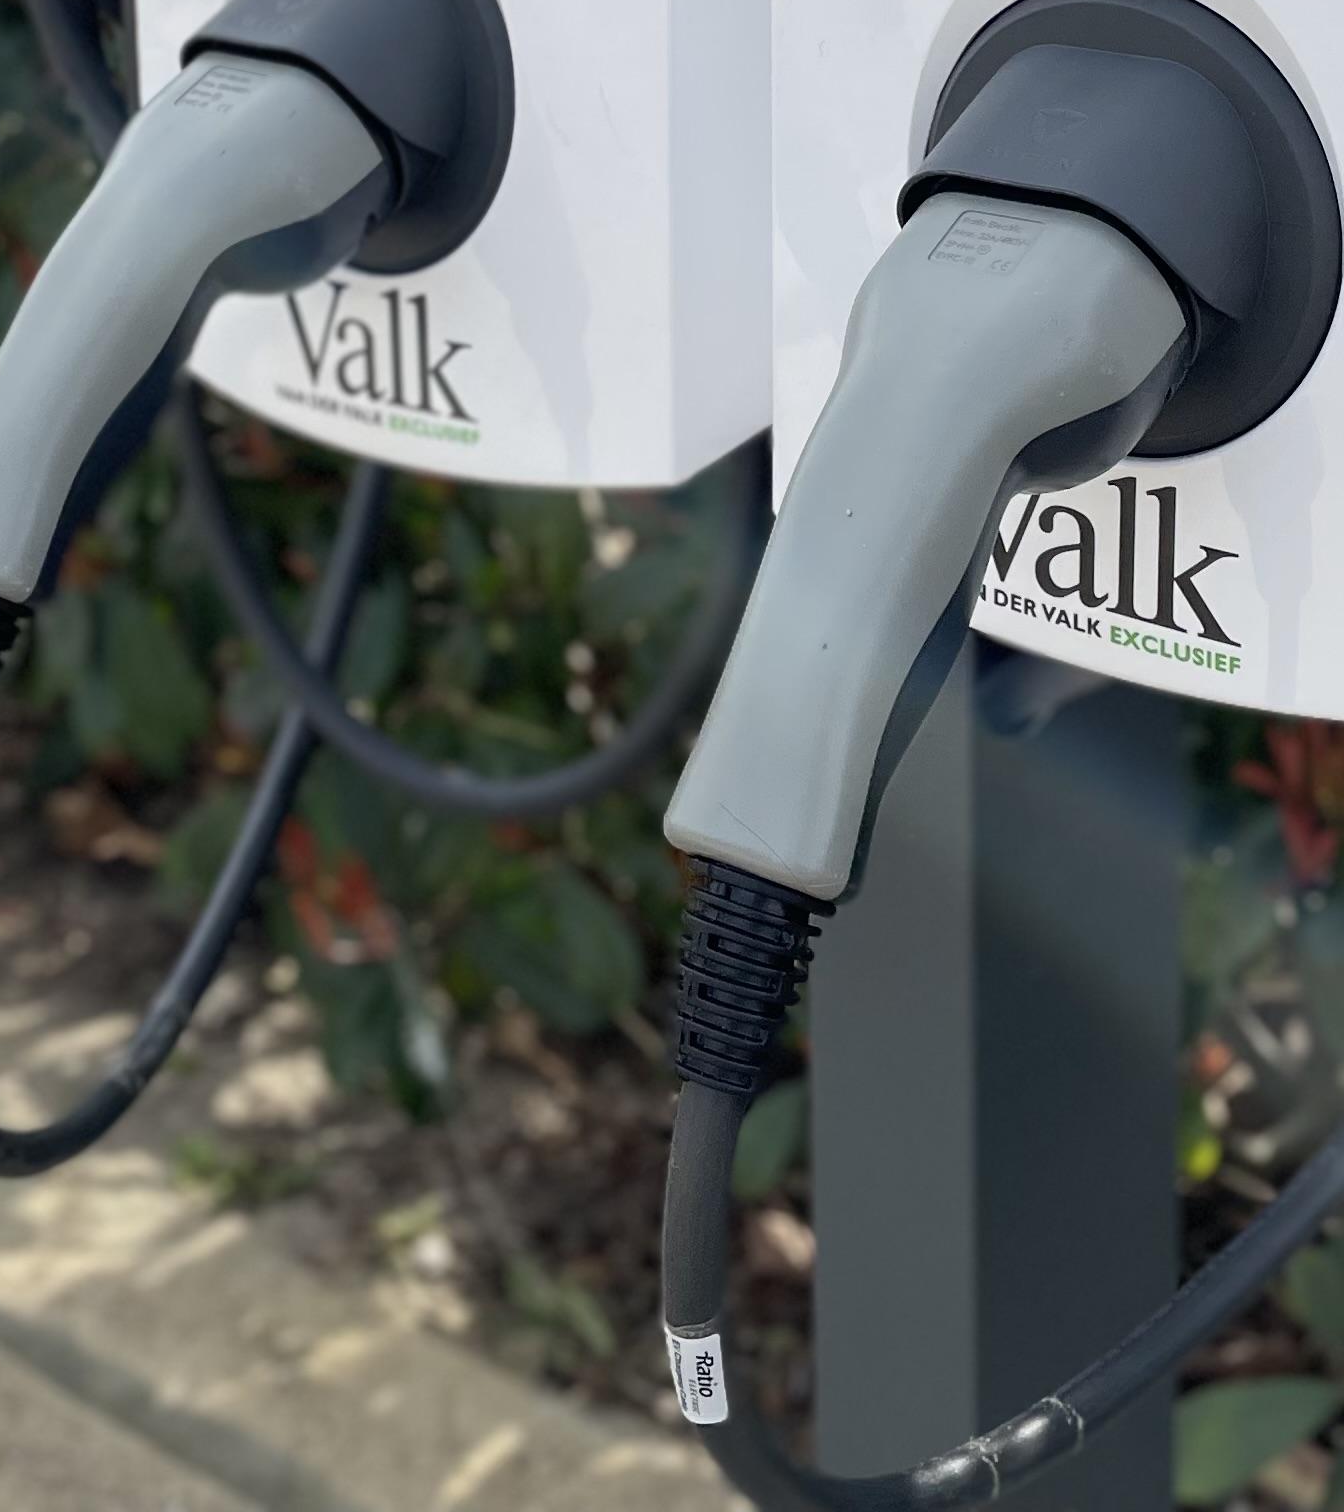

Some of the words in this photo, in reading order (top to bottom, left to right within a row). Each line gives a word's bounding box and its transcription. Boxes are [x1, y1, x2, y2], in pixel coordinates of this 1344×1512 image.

[285, 277, 479, 424] Valk
[993, 588, 1037, 618] DER
[1041, 603, 1102, 639] VALK
[1109, 624, 1242, 675] EXCLUSIEF
[696, 1351, 719, 1398] Ratio
